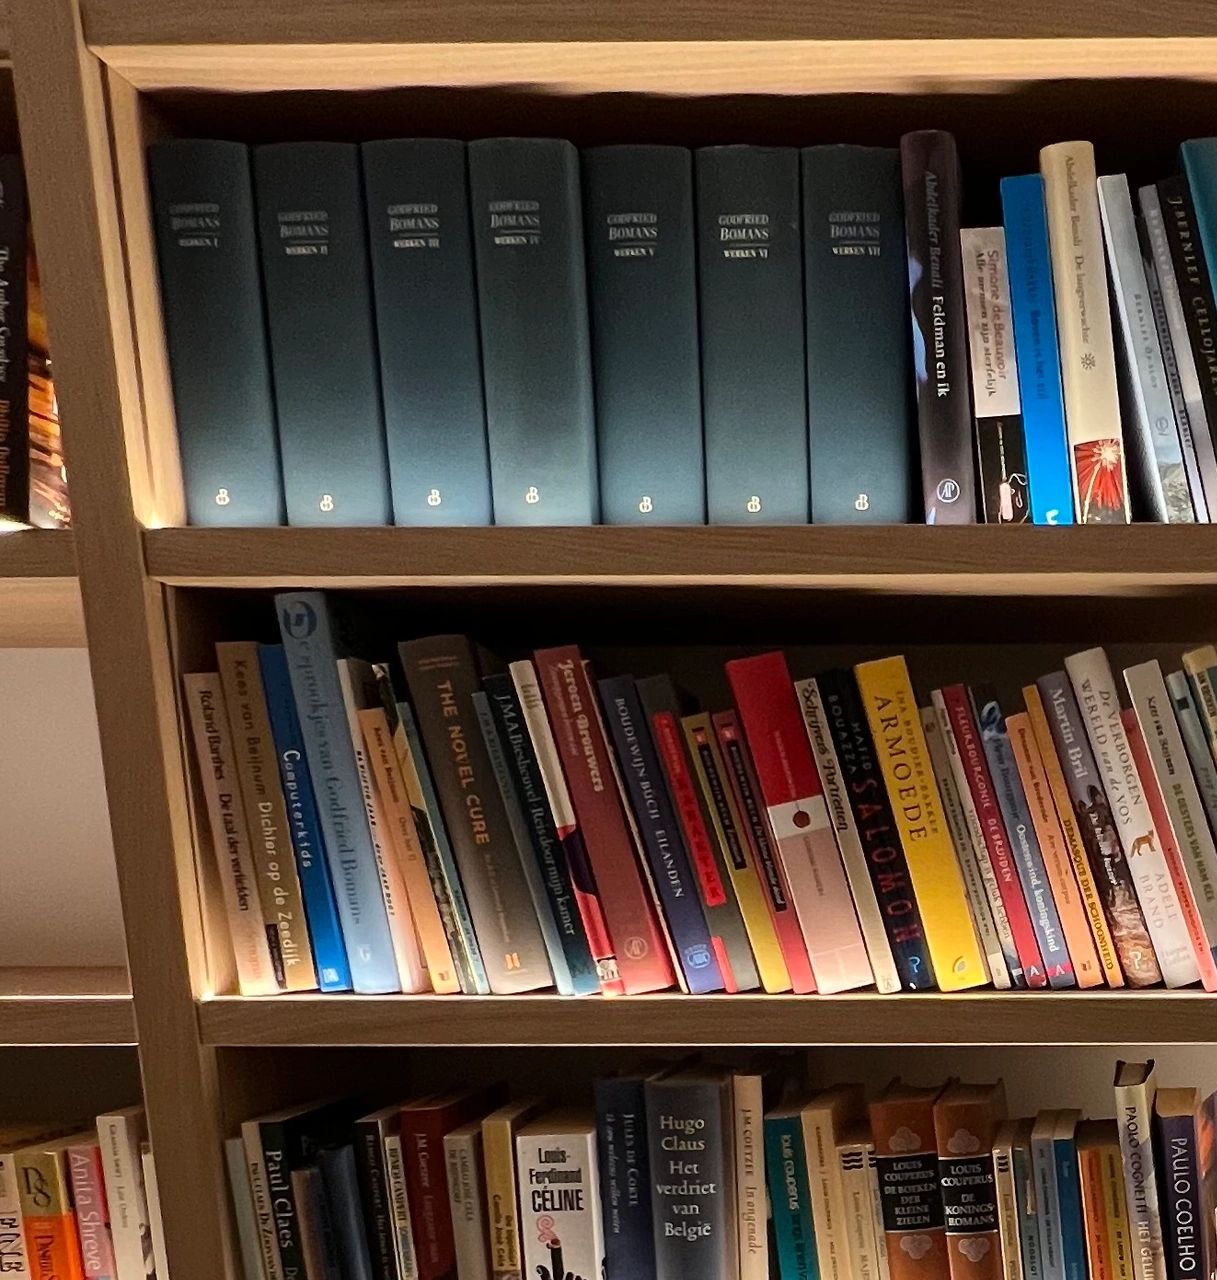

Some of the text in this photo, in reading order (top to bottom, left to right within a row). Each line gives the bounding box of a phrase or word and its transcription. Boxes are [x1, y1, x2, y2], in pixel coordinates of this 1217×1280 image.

[719, 214, 769, 225] GODFRIED
[720, 227, 769, 240] BOMANS
[933, 295, 949, 360] Feldman
[935, 362, 948, 379] en
[937, 381, 950, 398] ik
[827, 694, 857, 777] BOUAZZA
[850, 722, 873, 772] HAFID
[1050, 687, 1089, 780] Martin Bril
[1080, 678, 1132, 826] WERELD van de VOS
[1099, 690, 1143, 807] De VERBORGEN
[436, 679, 491, 846] THE NOVEL CURE
[874, 694, 929, 844] ARMOEDE
[232, 659, 300, 967] Kees van Beijnum Dichter op de Zeedijk
[281, 748, 312, 868] Computerkids
[851, 777, 923, 945] SALOMON
[1138, 874, 1164, 930] BRAND
[1154, 871, 1180, 921] ADELE
[660, 1115, 705, 1138] Hugo
[661, 1137, 706, 1152] Claus
[1124, 1105, 1139, 1151] PAOLO
[538, 1147, 571, 1165] Louis-
[669, 1160, 700, 1176] Het
[780, 1134, 800, 1211] louis couperus
[940, 1174, 994, 1187] COUPERUS
[949, 1163, 982, 1175] LOUIS
[1170, 1137, 1191, 1195] PAULO
[265, 1149, 294, 1249] Paul Claes
[531, 1185, 585, 1213] CÉLINE
[656, 1180, 718, 1197] verdriet
[1128, 1150, 1147, 1215] COGNETTI
[70, 1153, 102, 1271] Anita Shreve
[664, 1222, 713, 1242] België
[672, 1202, 700, 1217] van
[948, 1214, 995, 1226] ROMANS
[1137, 1220, 1149, 1245] HET
[1174, 1199, 1197, 1274] COELHO
